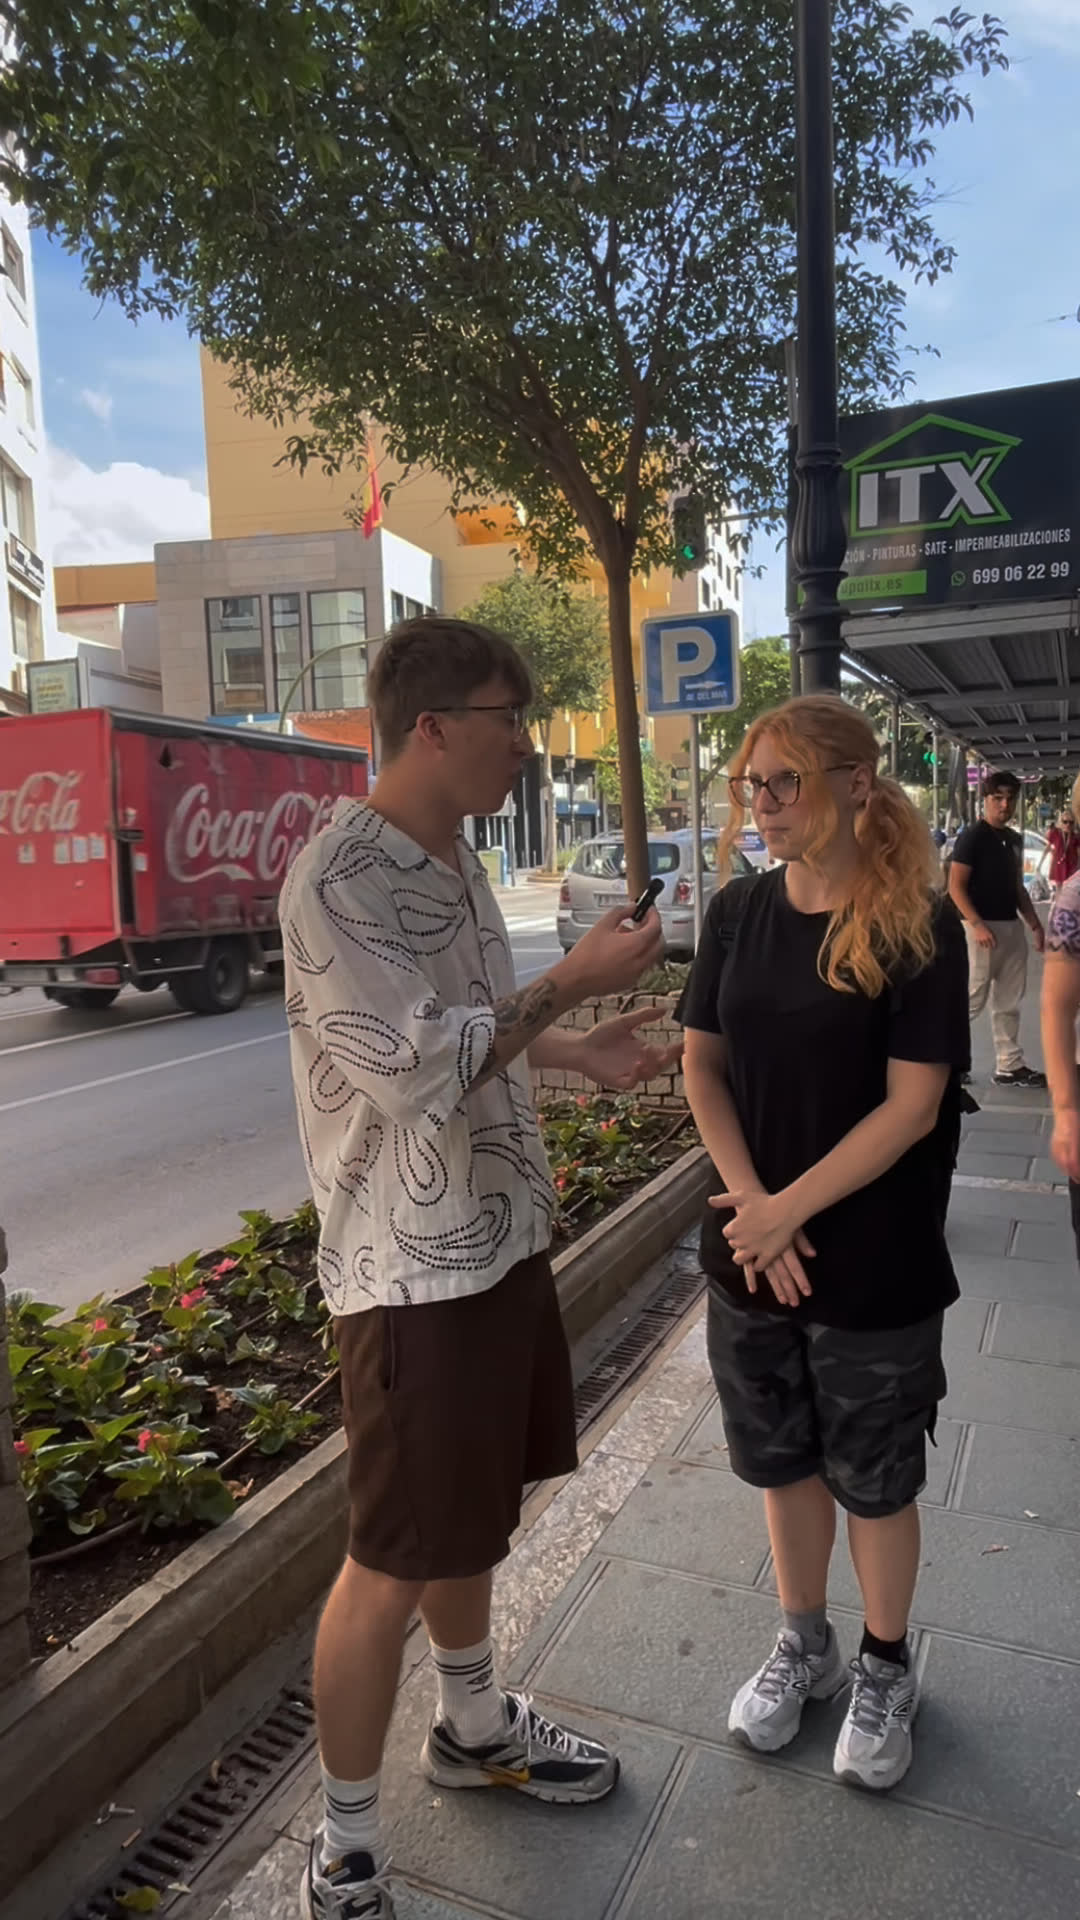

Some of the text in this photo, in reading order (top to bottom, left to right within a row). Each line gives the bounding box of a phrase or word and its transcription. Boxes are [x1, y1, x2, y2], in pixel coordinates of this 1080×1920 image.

[858, 456, 995, 529] ITX
[844, 547, 865, 564] CIÓN
[872, 543, 917, 561] PINTURAS
[924, 541, 948, 556] SATE
[955, 528, 1070, 553] IMPERMEABILIZACIONES
[841, 577, 903, 596] upoitx.es
[972, 561, 1070, 584] 699 06 22 99
[660, 627, 716, 703] P
